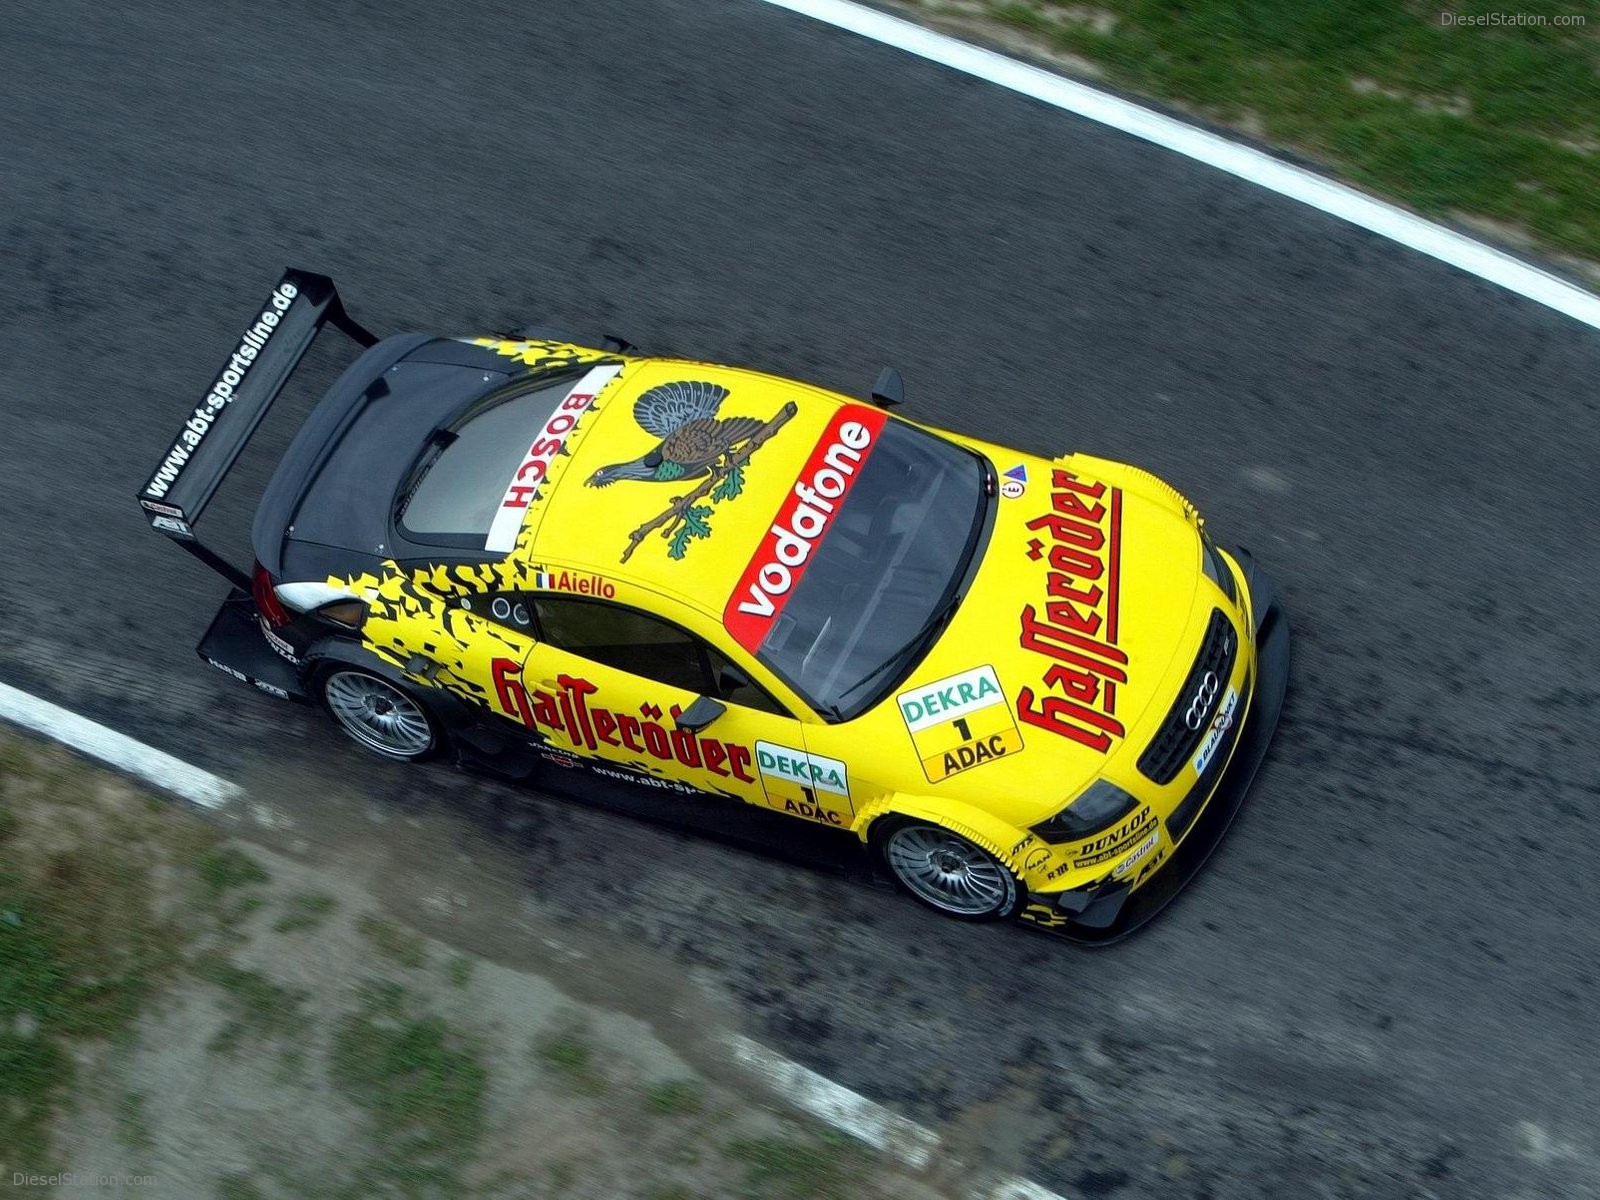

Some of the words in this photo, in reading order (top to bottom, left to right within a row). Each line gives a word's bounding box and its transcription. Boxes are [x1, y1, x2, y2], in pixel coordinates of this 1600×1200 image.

[147, 281, 299, 498] www.abt-sportsline.de
[503, 393, 594, 509] BOSCH
[738, 421, 872, 618] vodafone
[557, 571, 616, 600] Aiello
[902, 676, 999, 723] DEKRA
[952, 717, 973, 742] 1
[757, 750, 845, 790] DEKRA
[943, 735, 1007, 777] ADAC
[785, 798, 843, 825] ADAC
[800, 786, 816, 804] 1
[1079, 805, 1151, 857] DUNLOP
[1027, 854, 1051, 871] MAN
